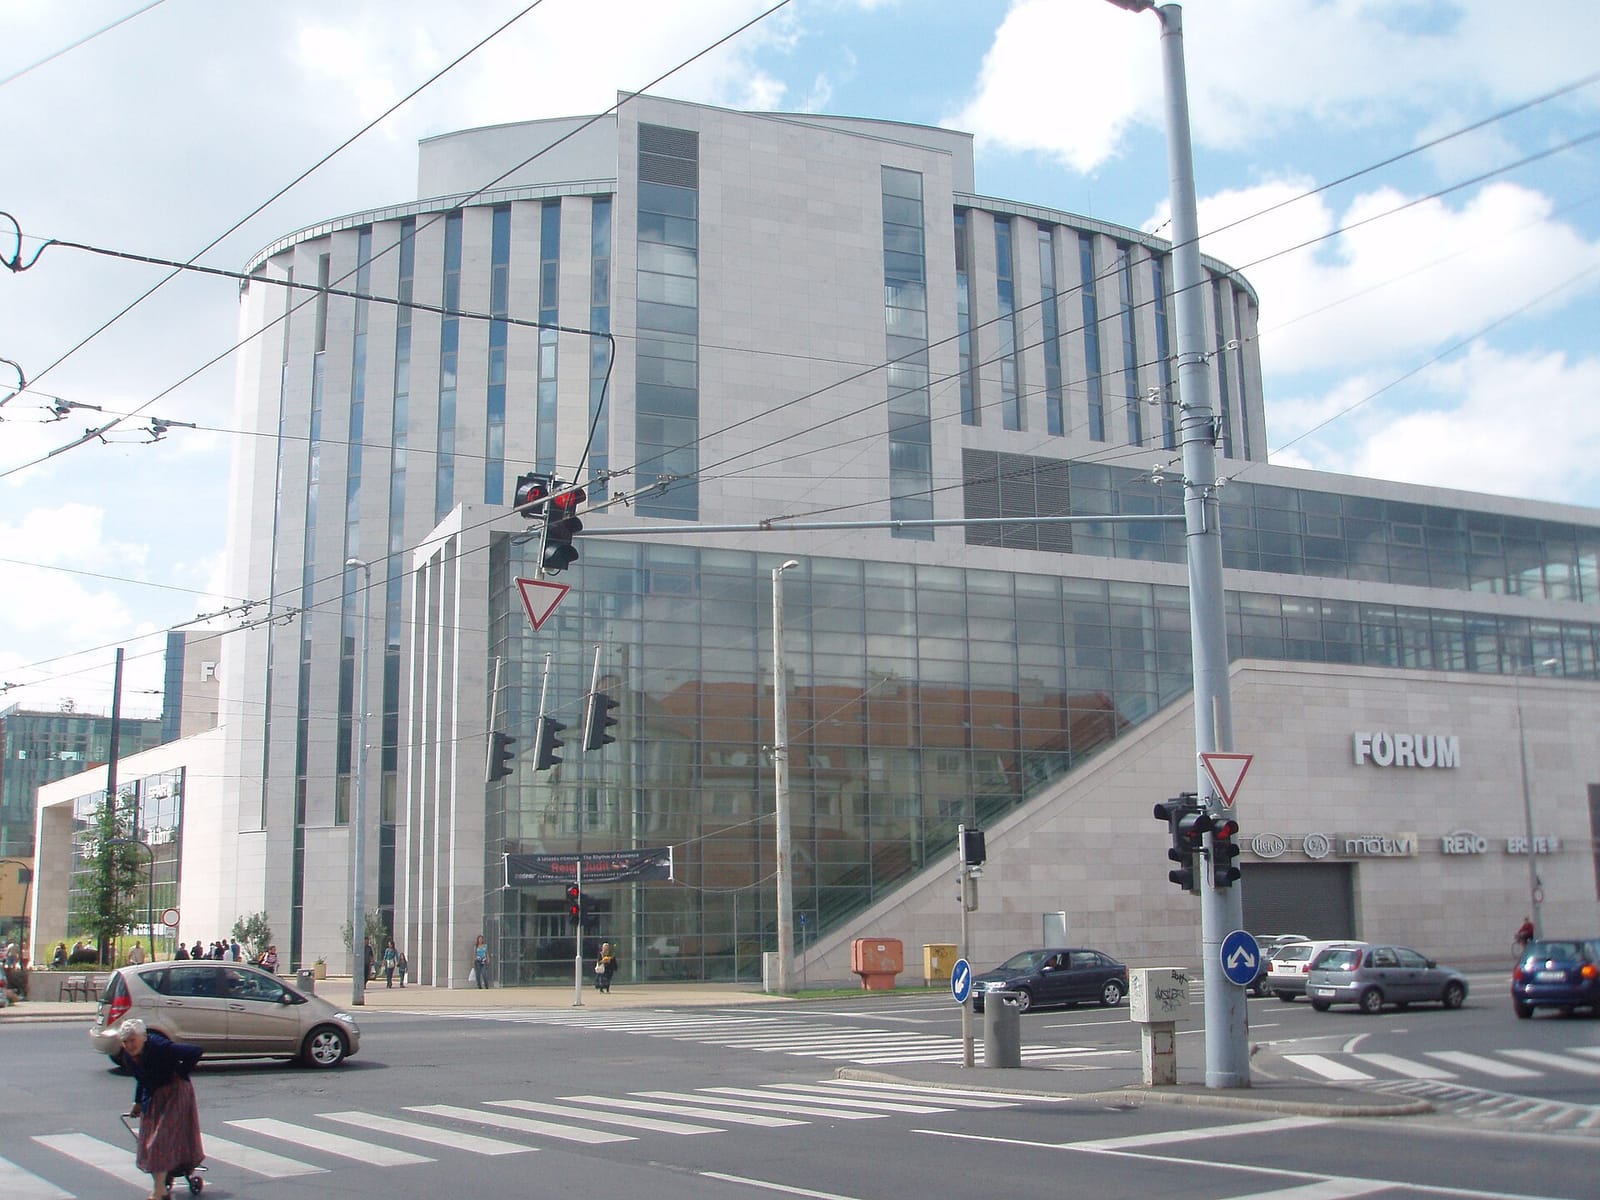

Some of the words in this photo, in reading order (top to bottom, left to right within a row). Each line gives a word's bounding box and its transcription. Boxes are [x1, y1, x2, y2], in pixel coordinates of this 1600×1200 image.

[1354, 731, 1460, 768] FORUM
[1442, 836, 1488, 854] RENO
[552, 862, 577, 874] Reig
